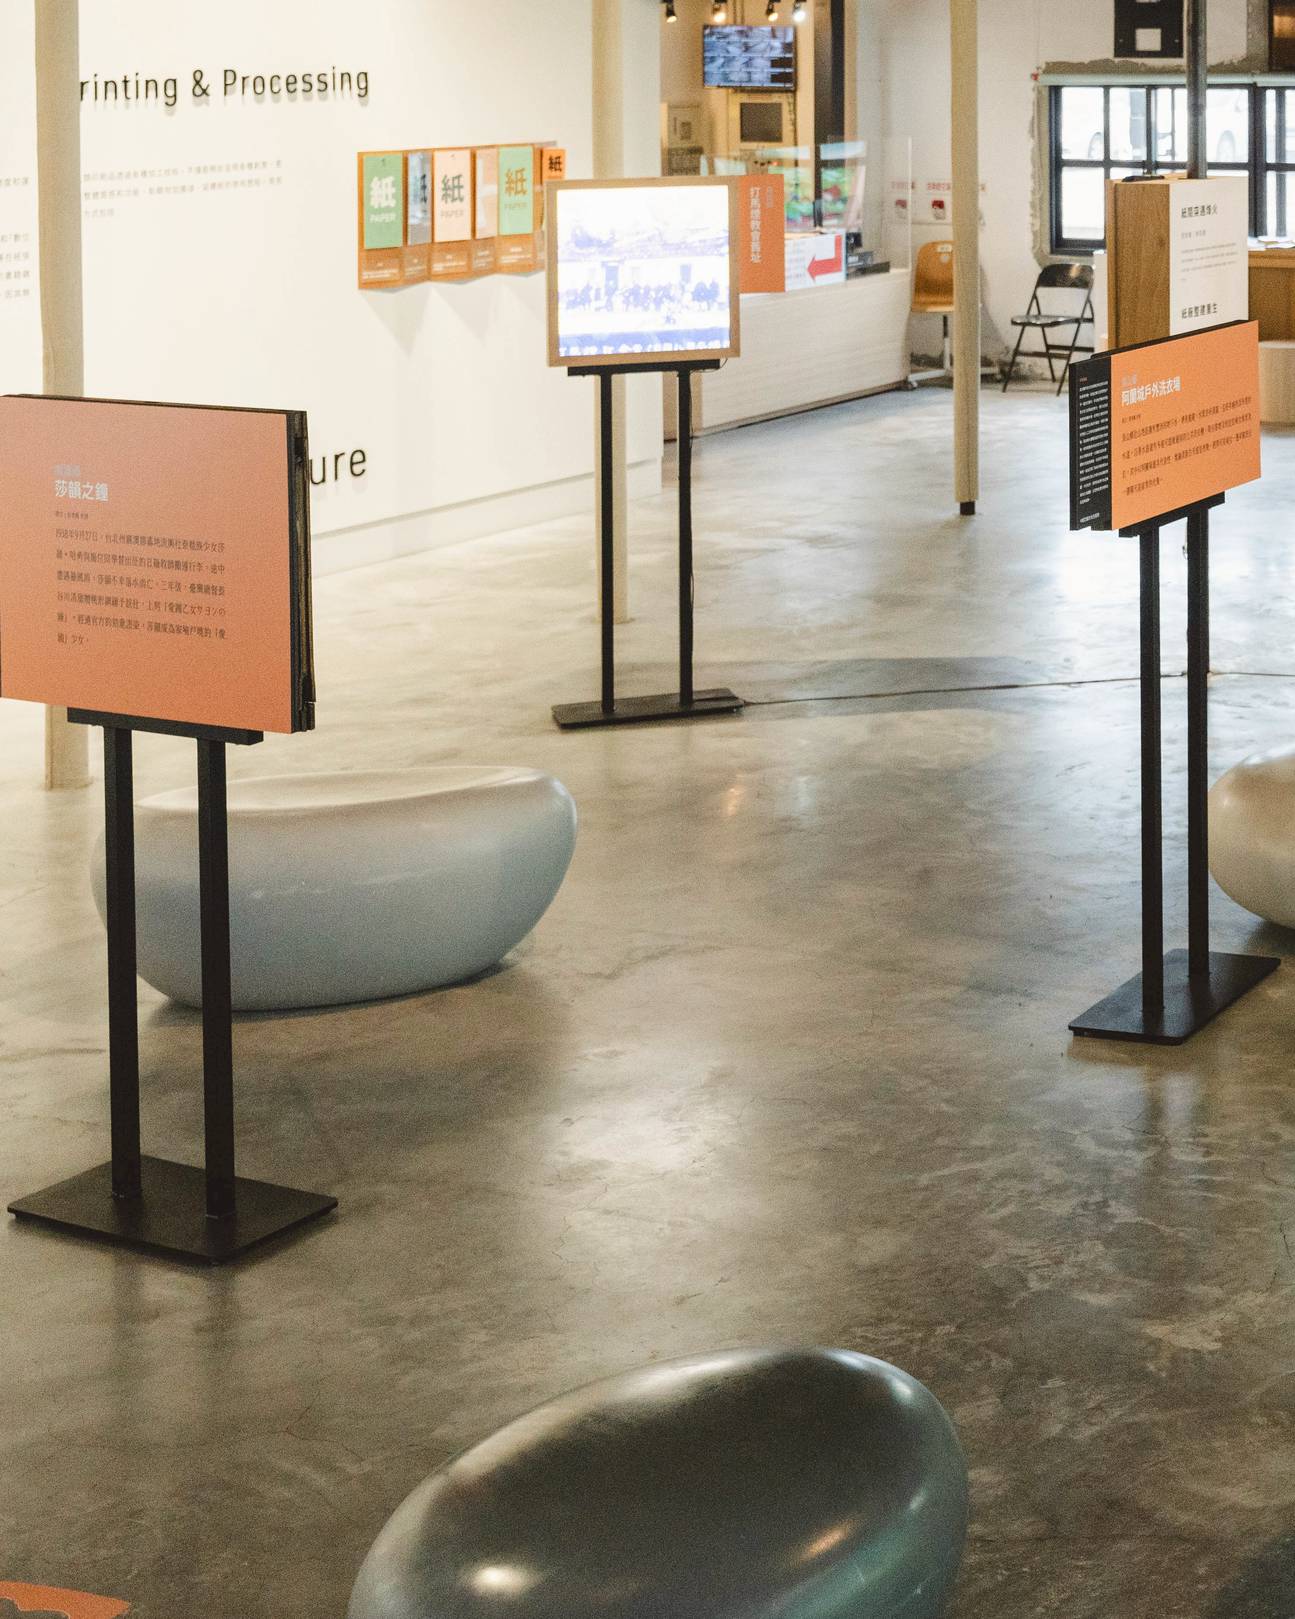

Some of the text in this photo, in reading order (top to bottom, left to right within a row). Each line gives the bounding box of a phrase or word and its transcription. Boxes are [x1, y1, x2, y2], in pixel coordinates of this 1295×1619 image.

[80, 66, 370, 107] rinting & Processing
[548, 154, 563, 172] 紙
[369, 175, 397, 210] 紙
[441, 173, 465, 205] 紙
[505, 167, 528, 197] 紙
[309, 449, 366, 485] ure
[55, 479, 109, 502] 莎韻之鐘
